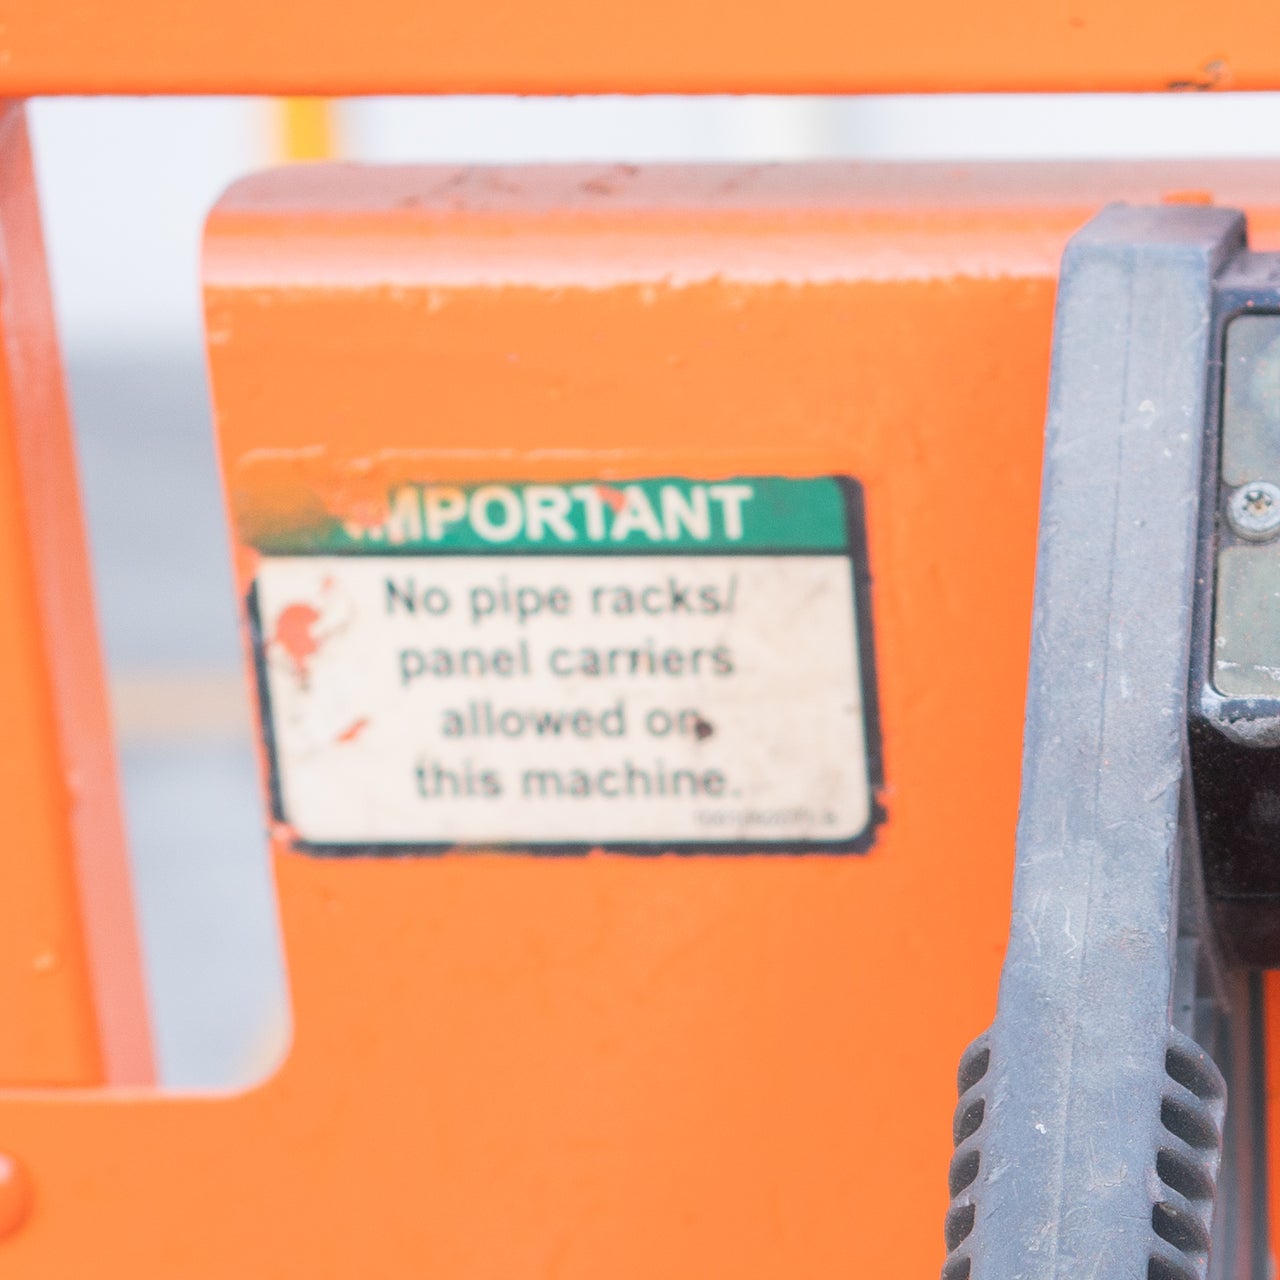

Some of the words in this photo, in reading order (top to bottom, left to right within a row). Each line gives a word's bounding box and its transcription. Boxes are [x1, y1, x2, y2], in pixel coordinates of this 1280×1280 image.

[343, 483, 754, 542] MPORTANT
[384, 577, 451, 614] No
[469, 575, 572, 624] pipe
[591, 574, 738, 614] racks/
[400, 641, 531, 685] panel
[549, 644, 734, 676] carriers
[442, 704, 626, 738] allowed
[646, 710, 699, 738] on
[416, 763, 502, 799] this
[521, 763, 743, 799] machine.
